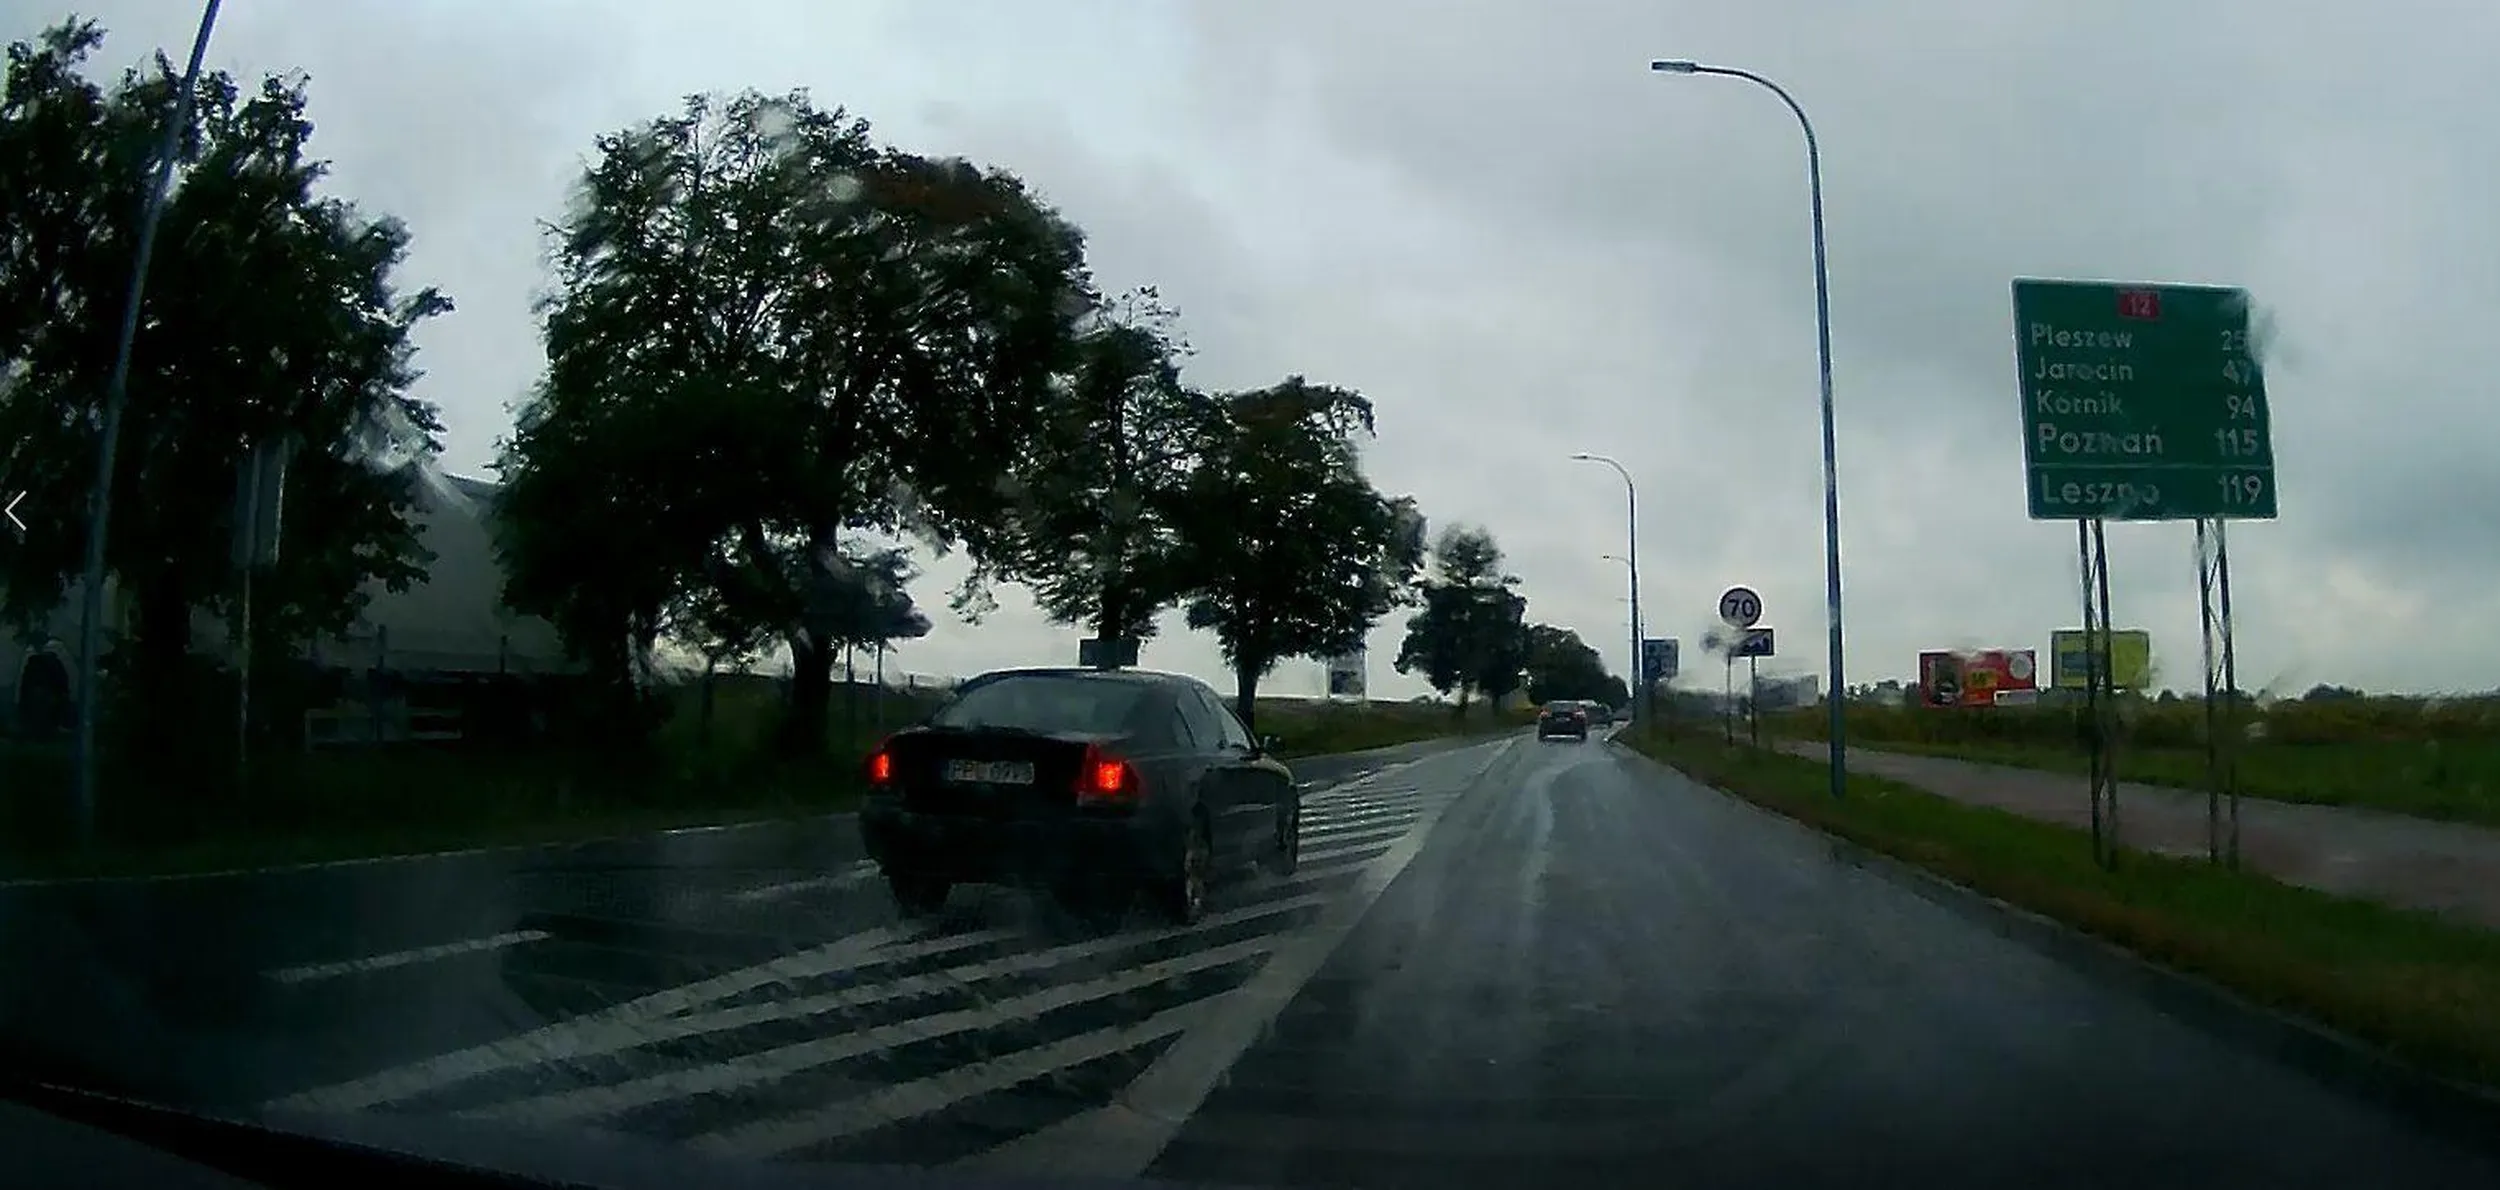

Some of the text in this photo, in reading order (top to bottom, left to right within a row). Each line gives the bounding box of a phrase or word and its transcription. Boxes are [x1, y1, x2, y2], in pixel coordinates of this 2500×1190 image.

[2131, 298, 2151, 316] 12
[2031, 323, 2248, 351] Pleszew 25
[2035, 357, 2252, 385] Jarocin 47
[2226, 395, 2256, 419] 94
[2038, 423, 2258, 456] Poznań 115
[2042, 474, 2262, 505] Leszno 119
[1727, 599, 1755, 617] 70
